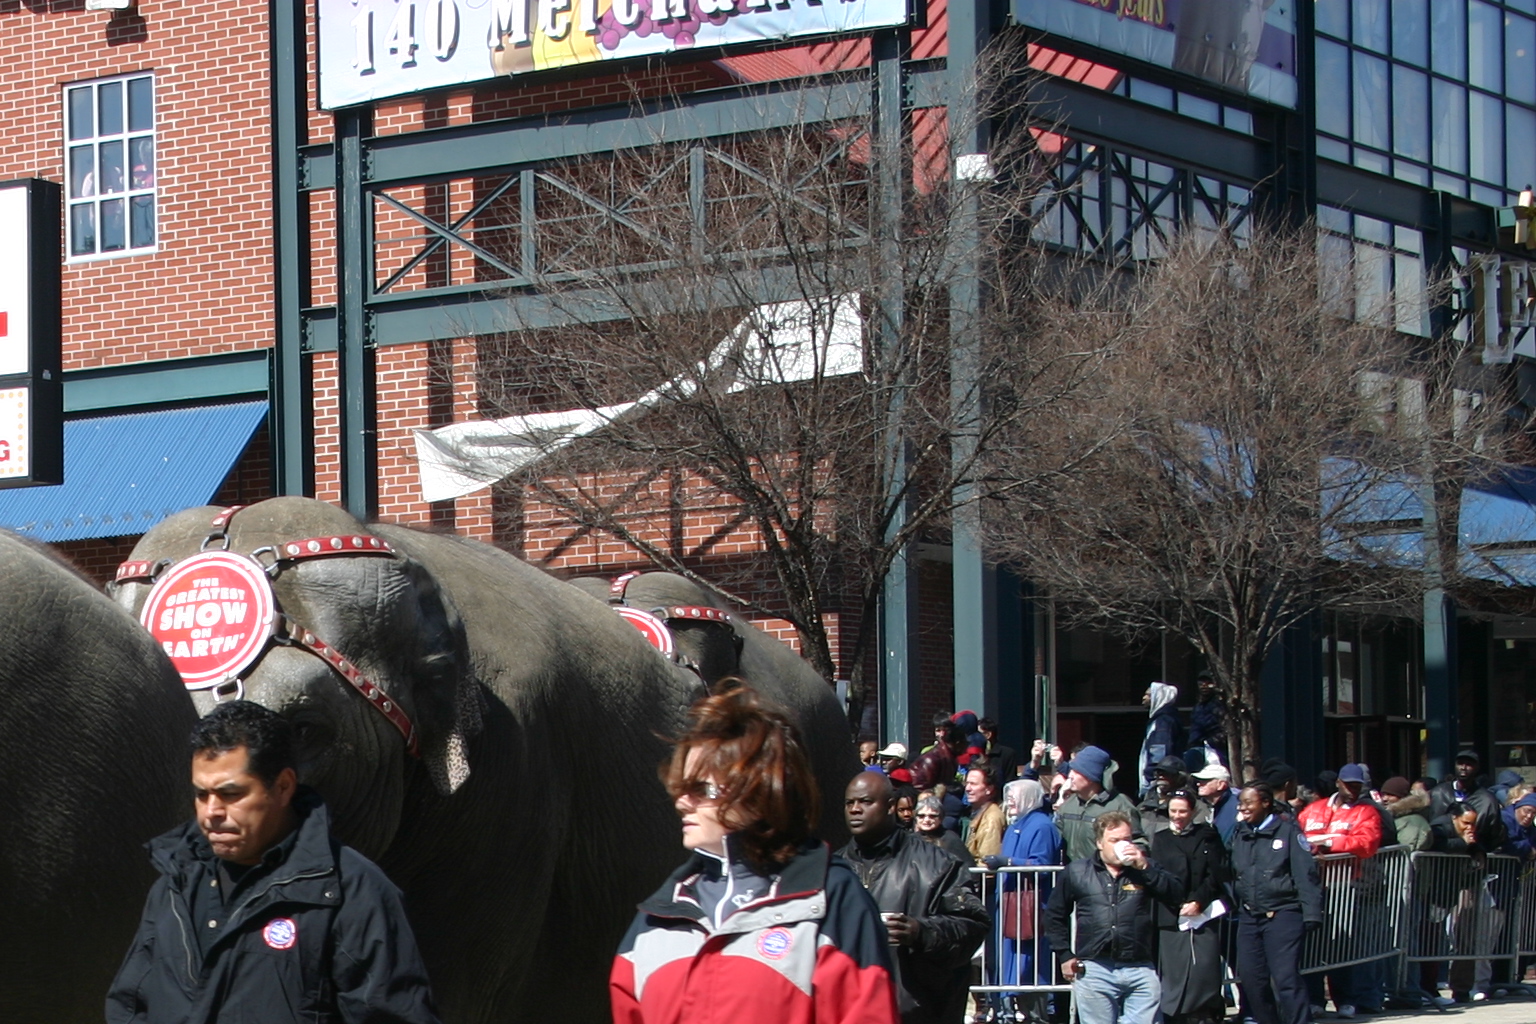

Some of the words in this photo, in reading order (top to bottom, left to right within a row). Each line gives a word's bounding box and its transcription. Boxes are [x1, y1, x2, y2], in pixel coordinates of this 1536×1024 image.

[350, 0, 460, 74] 140
[192, 578, 219, 588] THE
[165, 587, 245, 607] GREATEST
[159, 602, 247, 631] SHOW
[190, 628, 212, 639] ON
